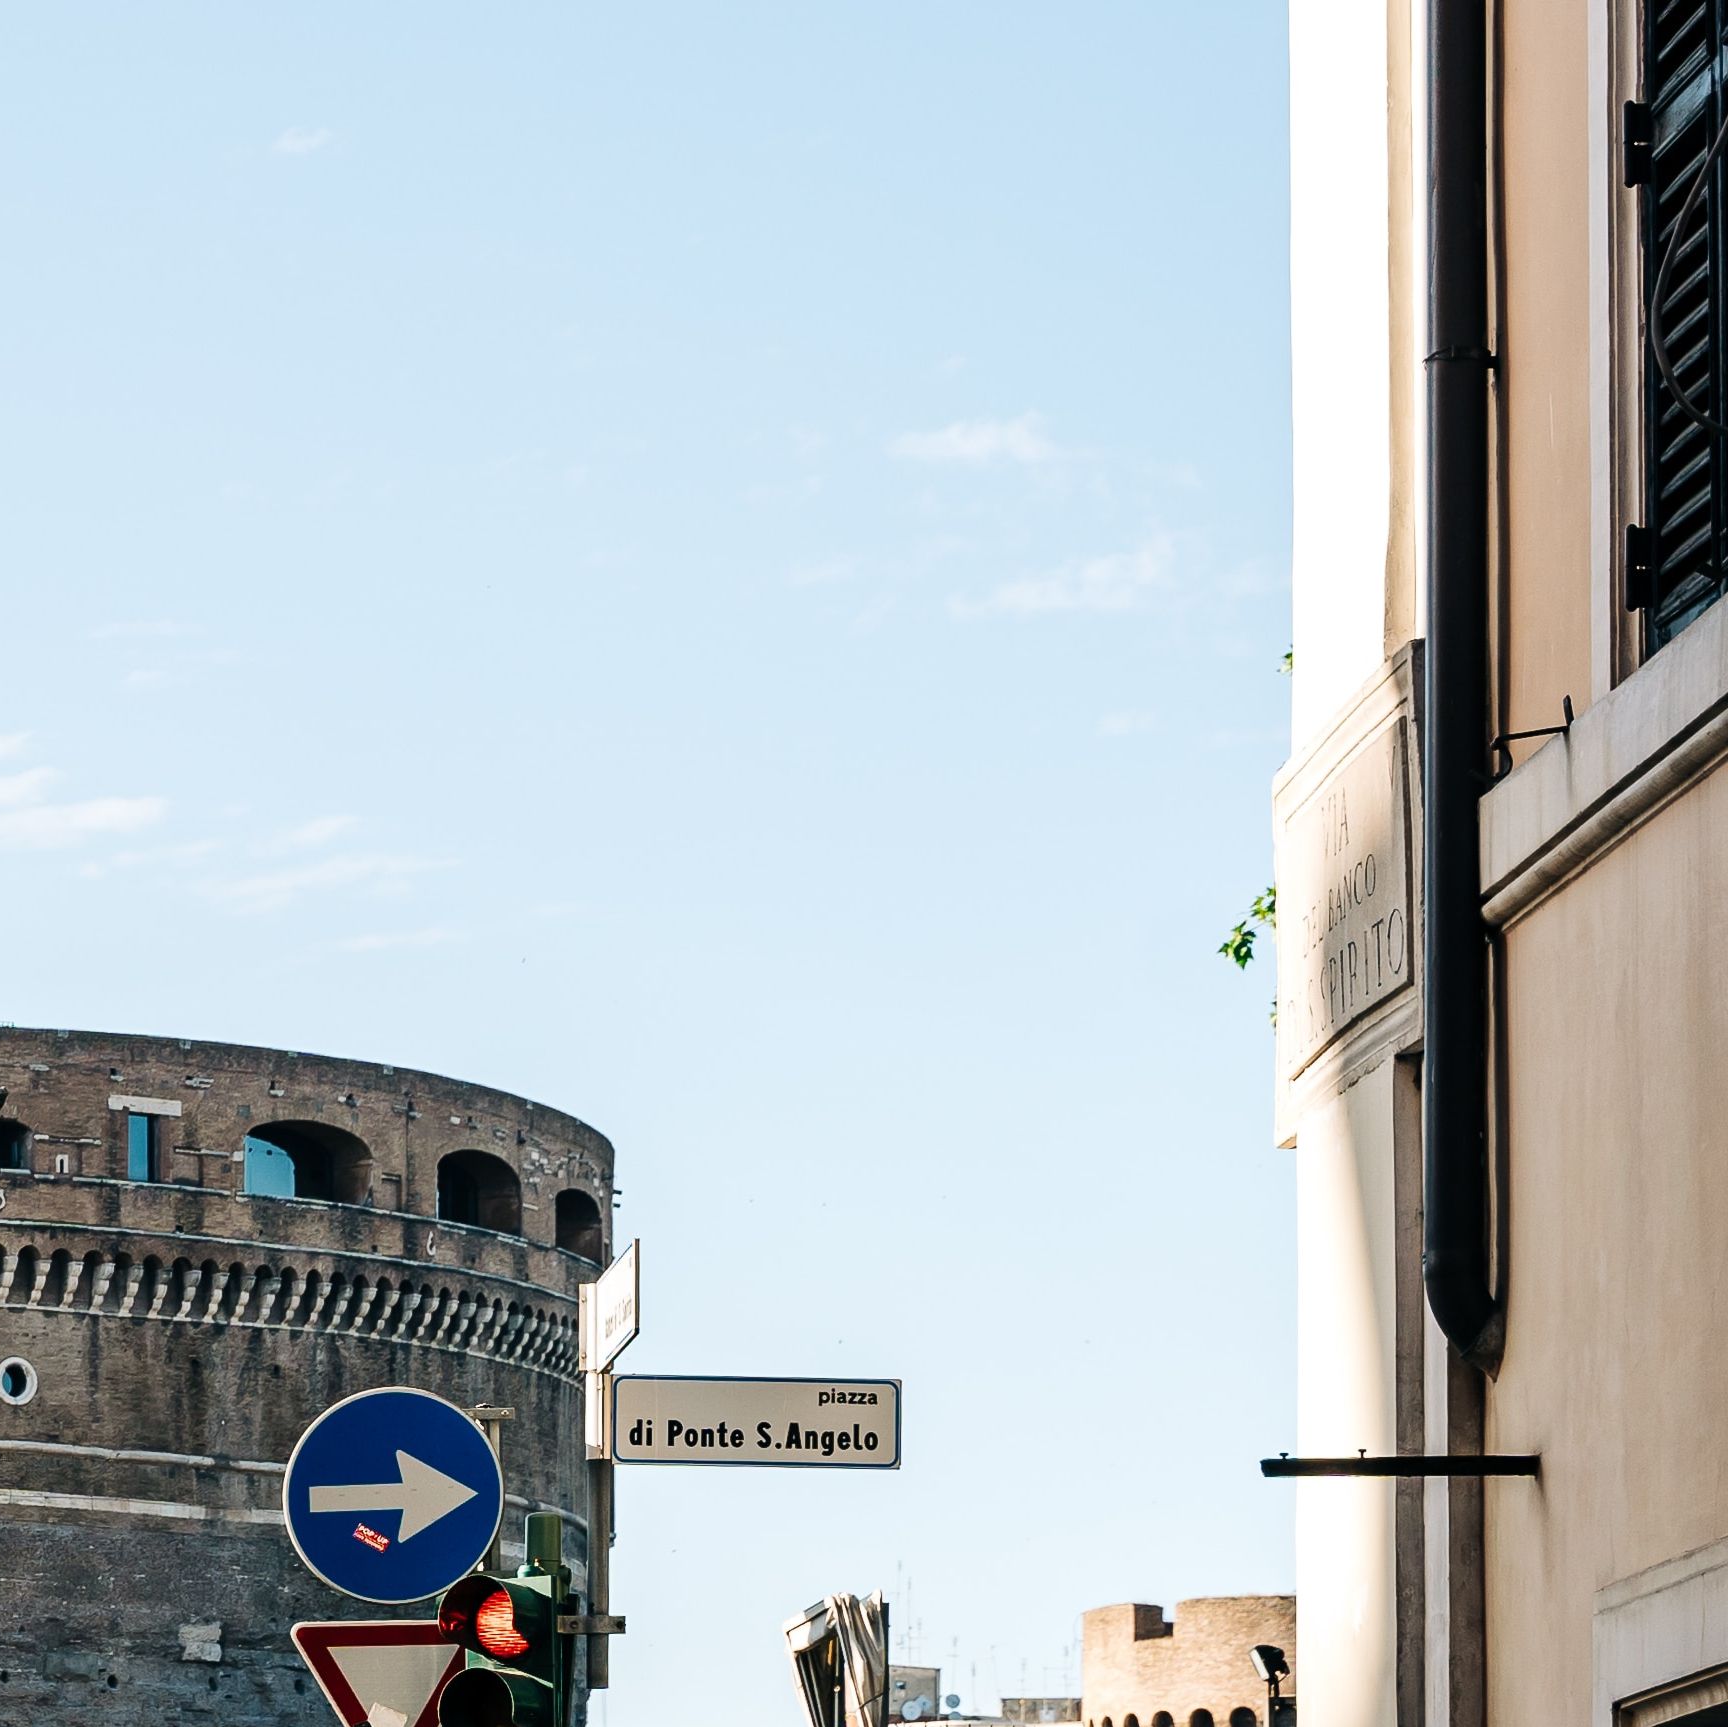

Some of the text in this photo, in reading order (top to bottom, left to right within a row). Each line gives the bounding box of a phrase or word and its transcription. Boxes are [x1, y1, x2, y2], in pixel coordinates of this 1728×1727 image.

[1321, 788, 1350, 857] VIA
[1327, 853, 1377, 933] BANCO
[818, 1388, 879, 1407] piazza
[629, 1419, 879, 1456] di Ponte S.Angelo
